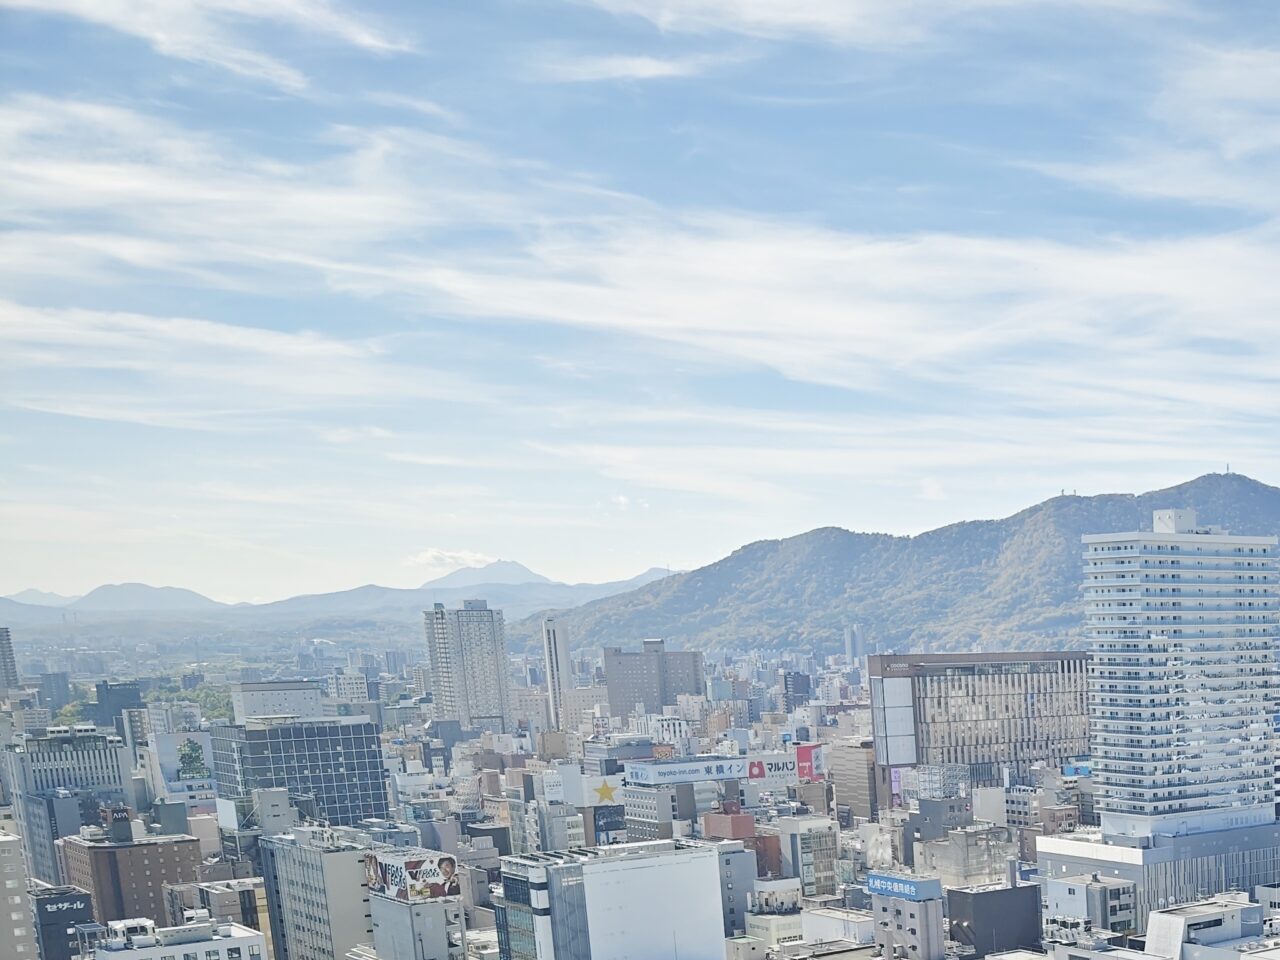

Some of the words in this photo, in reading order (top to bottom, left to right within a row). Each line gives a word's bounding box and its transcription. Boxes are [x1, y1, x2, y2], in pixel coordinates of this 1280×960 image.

[657, 767, 700, 777] toyoko-inn.com
[703, 762, 744, 776] 東横イン
[766, 761, 796, 772] マルハン
[113, 811, 129, 820] APA
[868, 877, 917, 896] 札幌中央信用組合
[45, 901, 85, 913] セザール
